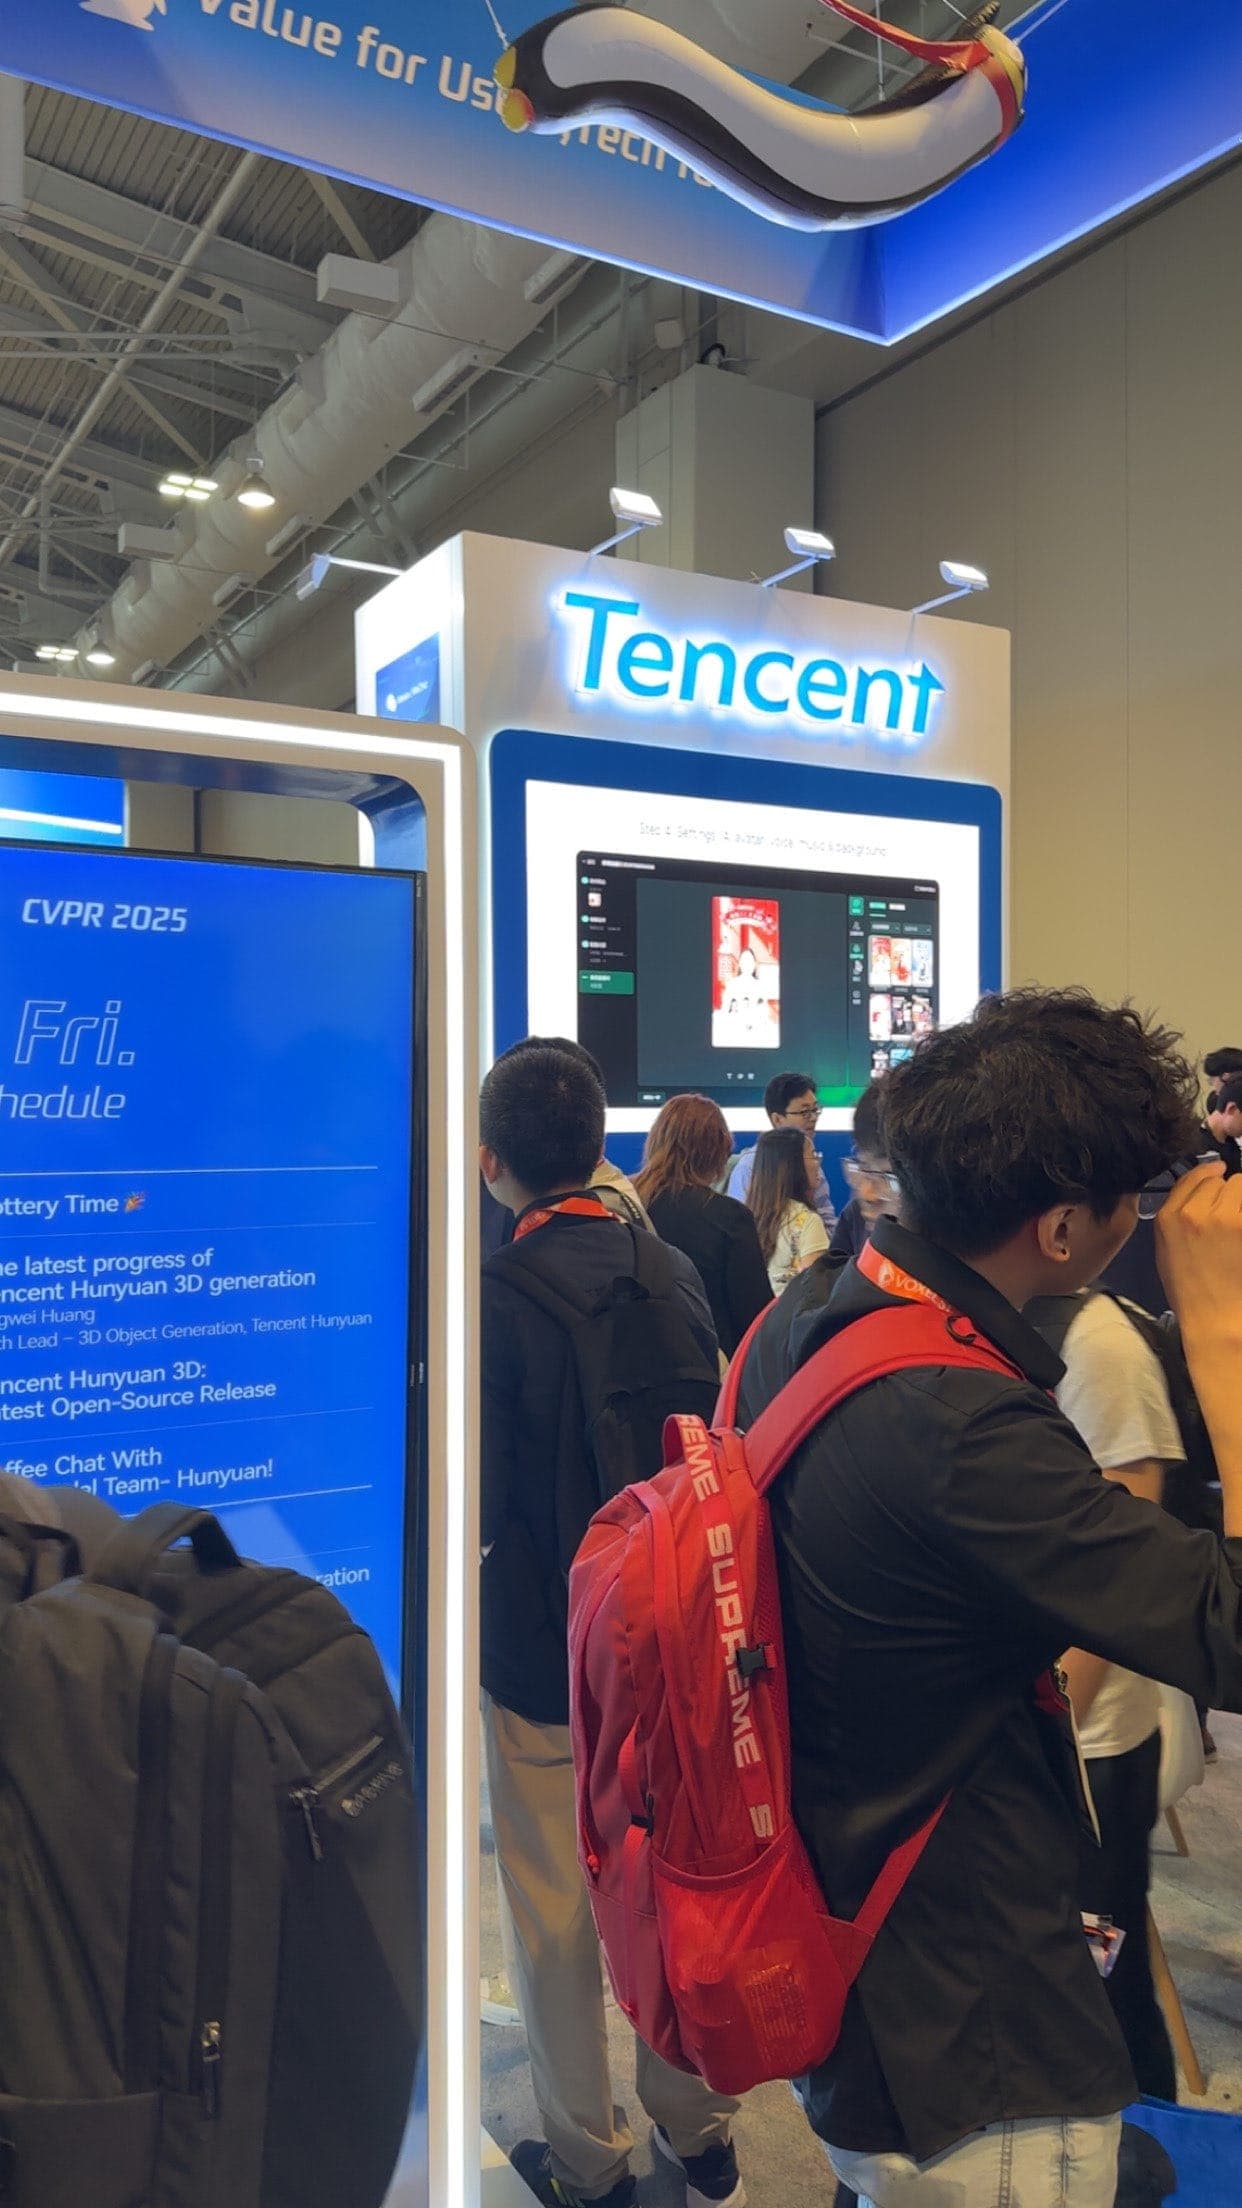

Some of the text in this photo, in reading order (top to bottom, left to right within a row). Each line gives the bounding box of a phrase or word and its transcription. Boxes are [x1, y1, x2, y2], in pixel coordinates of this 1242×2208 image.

[356, 25, 427, 85] for
[565, 592, 946, 734] Tencent
[22, 899, 188, 933] CVPR 2025
[14, 1000, 136, 1066] Fri.
[0, 1195, 119, 1220] ttery Time
[24, 1255, 87, 1275] latest
[93, 1253, 186, 1277] progress
[191, 1248, 215, 1267] of
[0, 1269, 316, 1302] ncent Hunyuan 3D generation
[0, 1334, 13, 1350] h
[18, 1331, 58, 1350] Lead
[78, 1330, 102, 1345] 3D
[105, 1327, 158, 1346] Object
[162, 1320, 248, 1339] Generation,
[252, 1316, 308, 1333] Tencent
[311, 1313, 373, 1331] Hunyuan
[41, 1308, 96, 1325] Huang
[70, 1368, 165, 1392] Hunyuan
[172, 1361, 207, 1380] 3D:
[0, 1383, 277, 1420] test Open-Source Release
[54, 1454, 106, 1475] Chat
[111, 1446, 162, 1469] With
[177, 1459, 273, 1489] Hunyuan!
[706, 1523, 762, 1768] SUPREME
